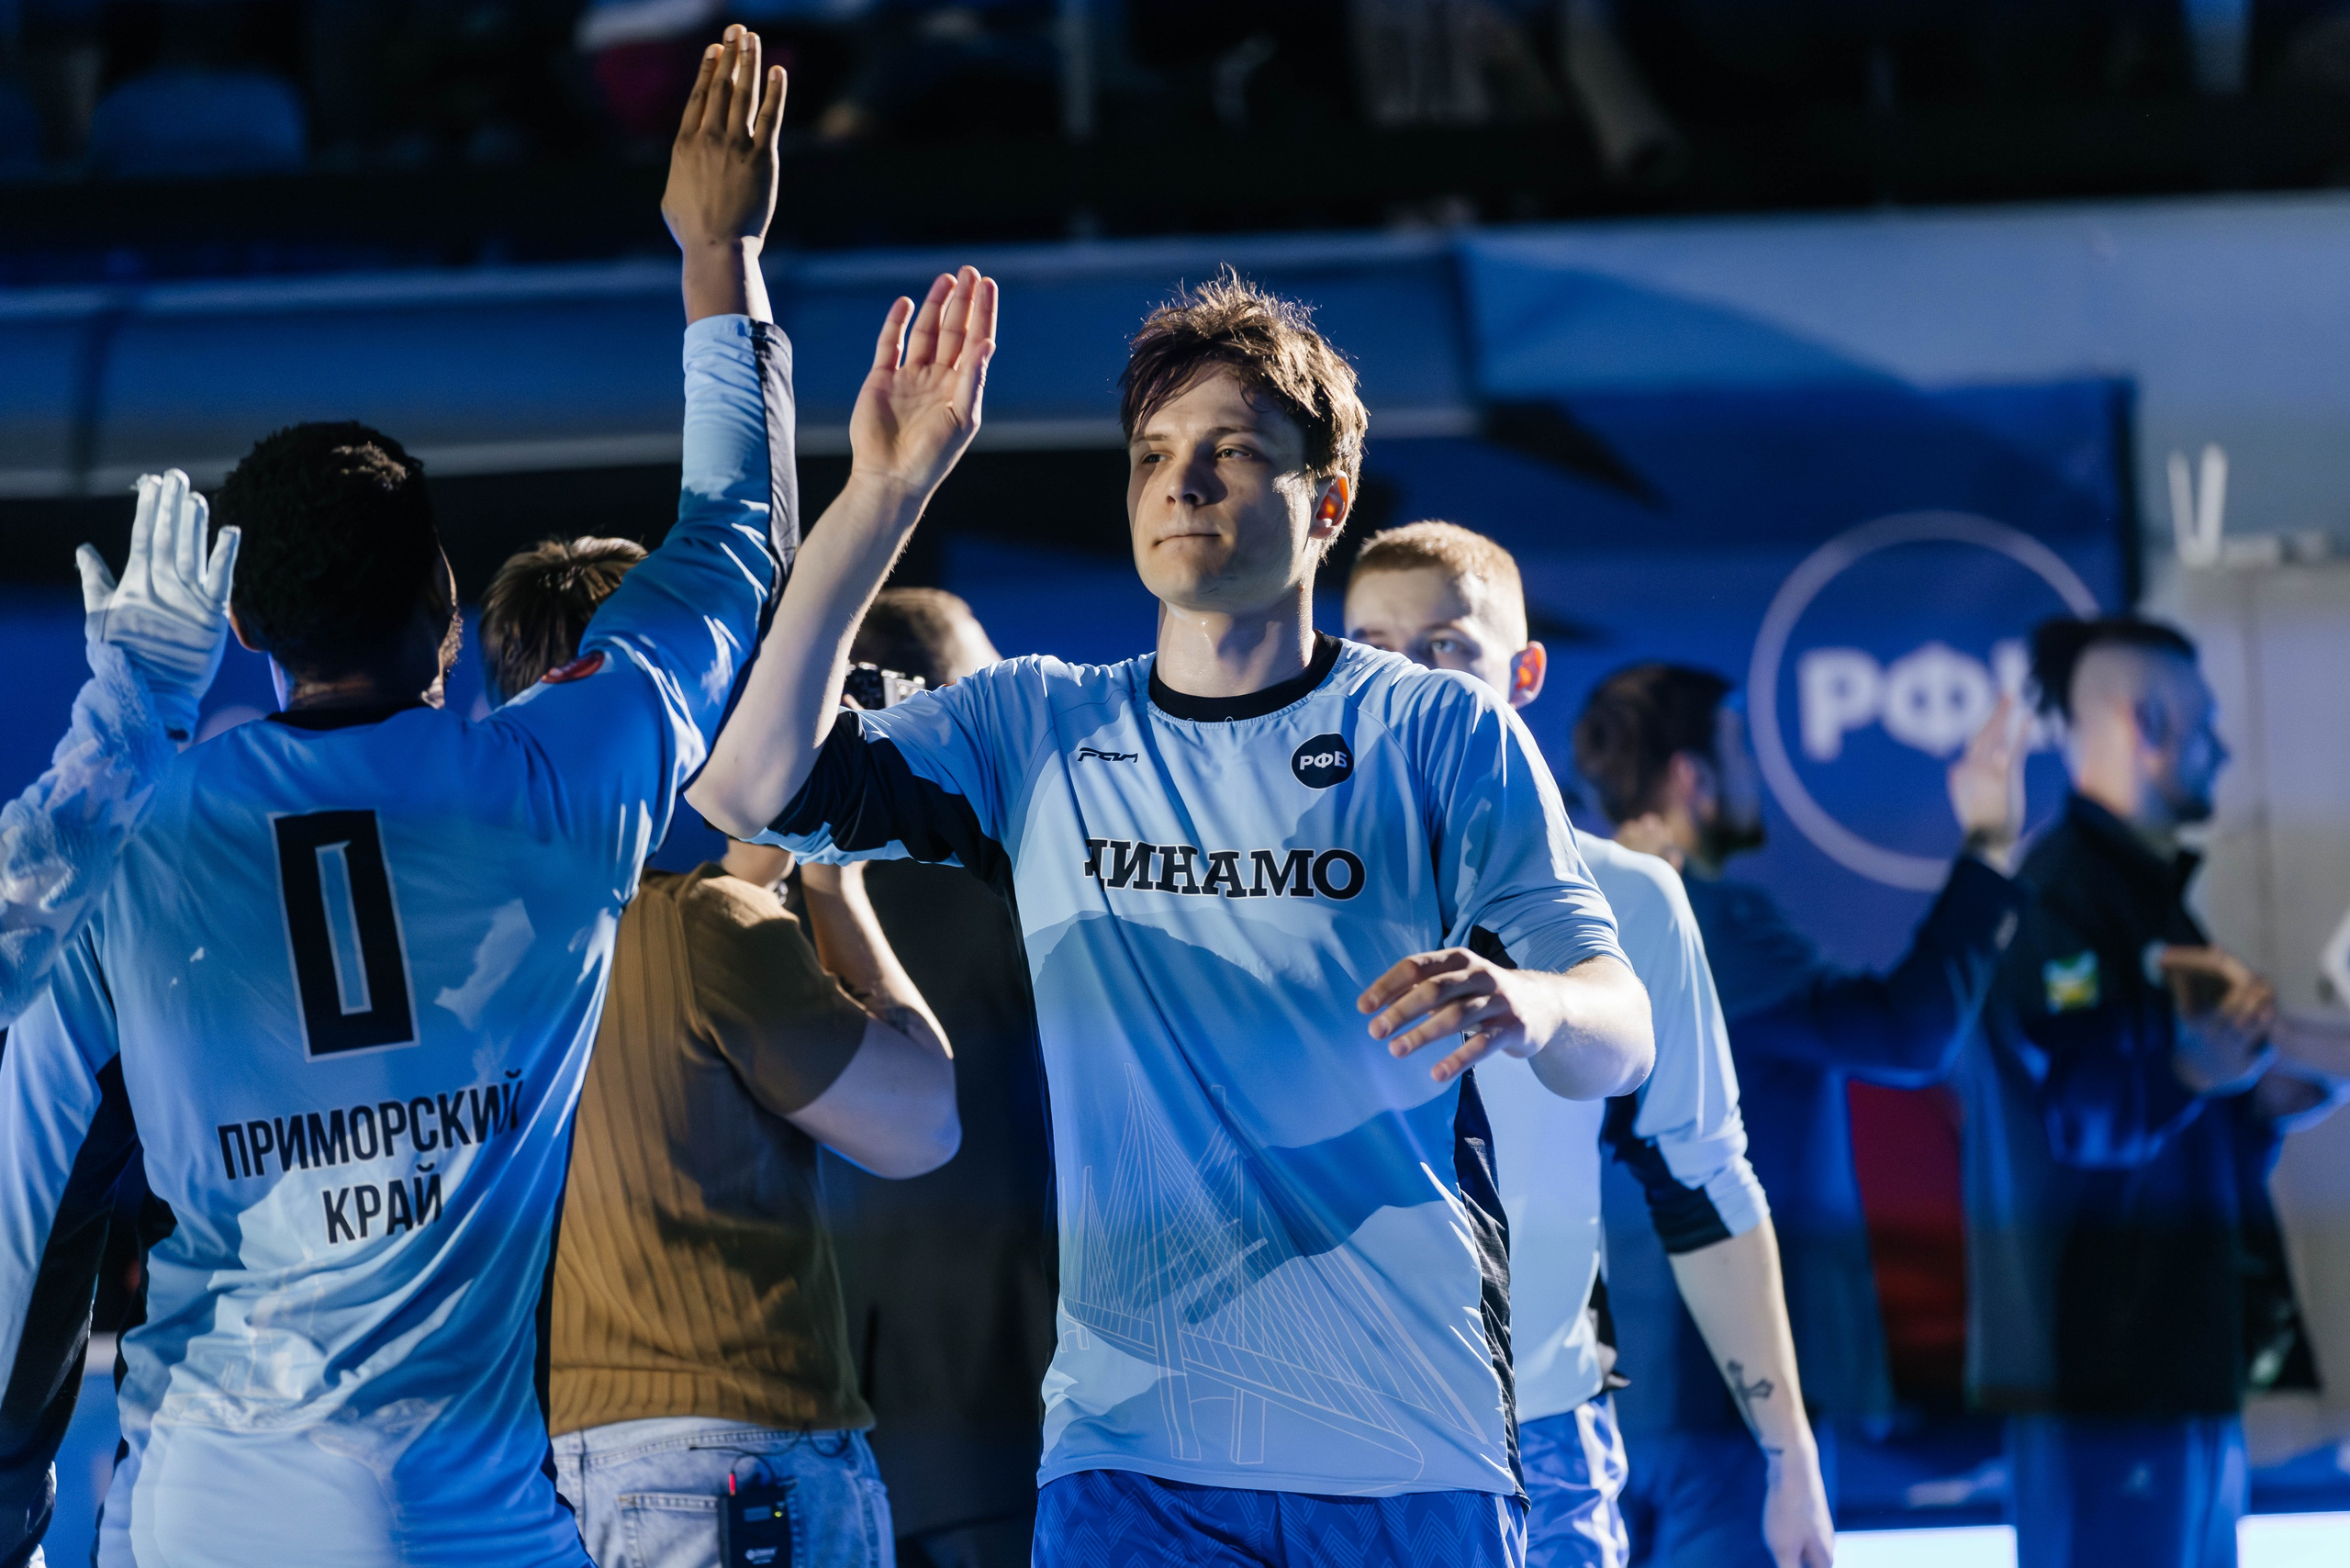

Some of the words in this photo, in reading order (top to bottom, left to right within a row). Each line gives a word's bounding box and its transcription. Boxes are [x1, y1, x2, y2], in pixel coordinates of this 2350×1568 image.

[1299, 750, 1348, 770] РФБ
[268, 808, 420, 1061] 0
[217, 1068, 524, 1182] ПРИМОРСКИЙ
[321, 1161, 444, 1246] КРАЙ
